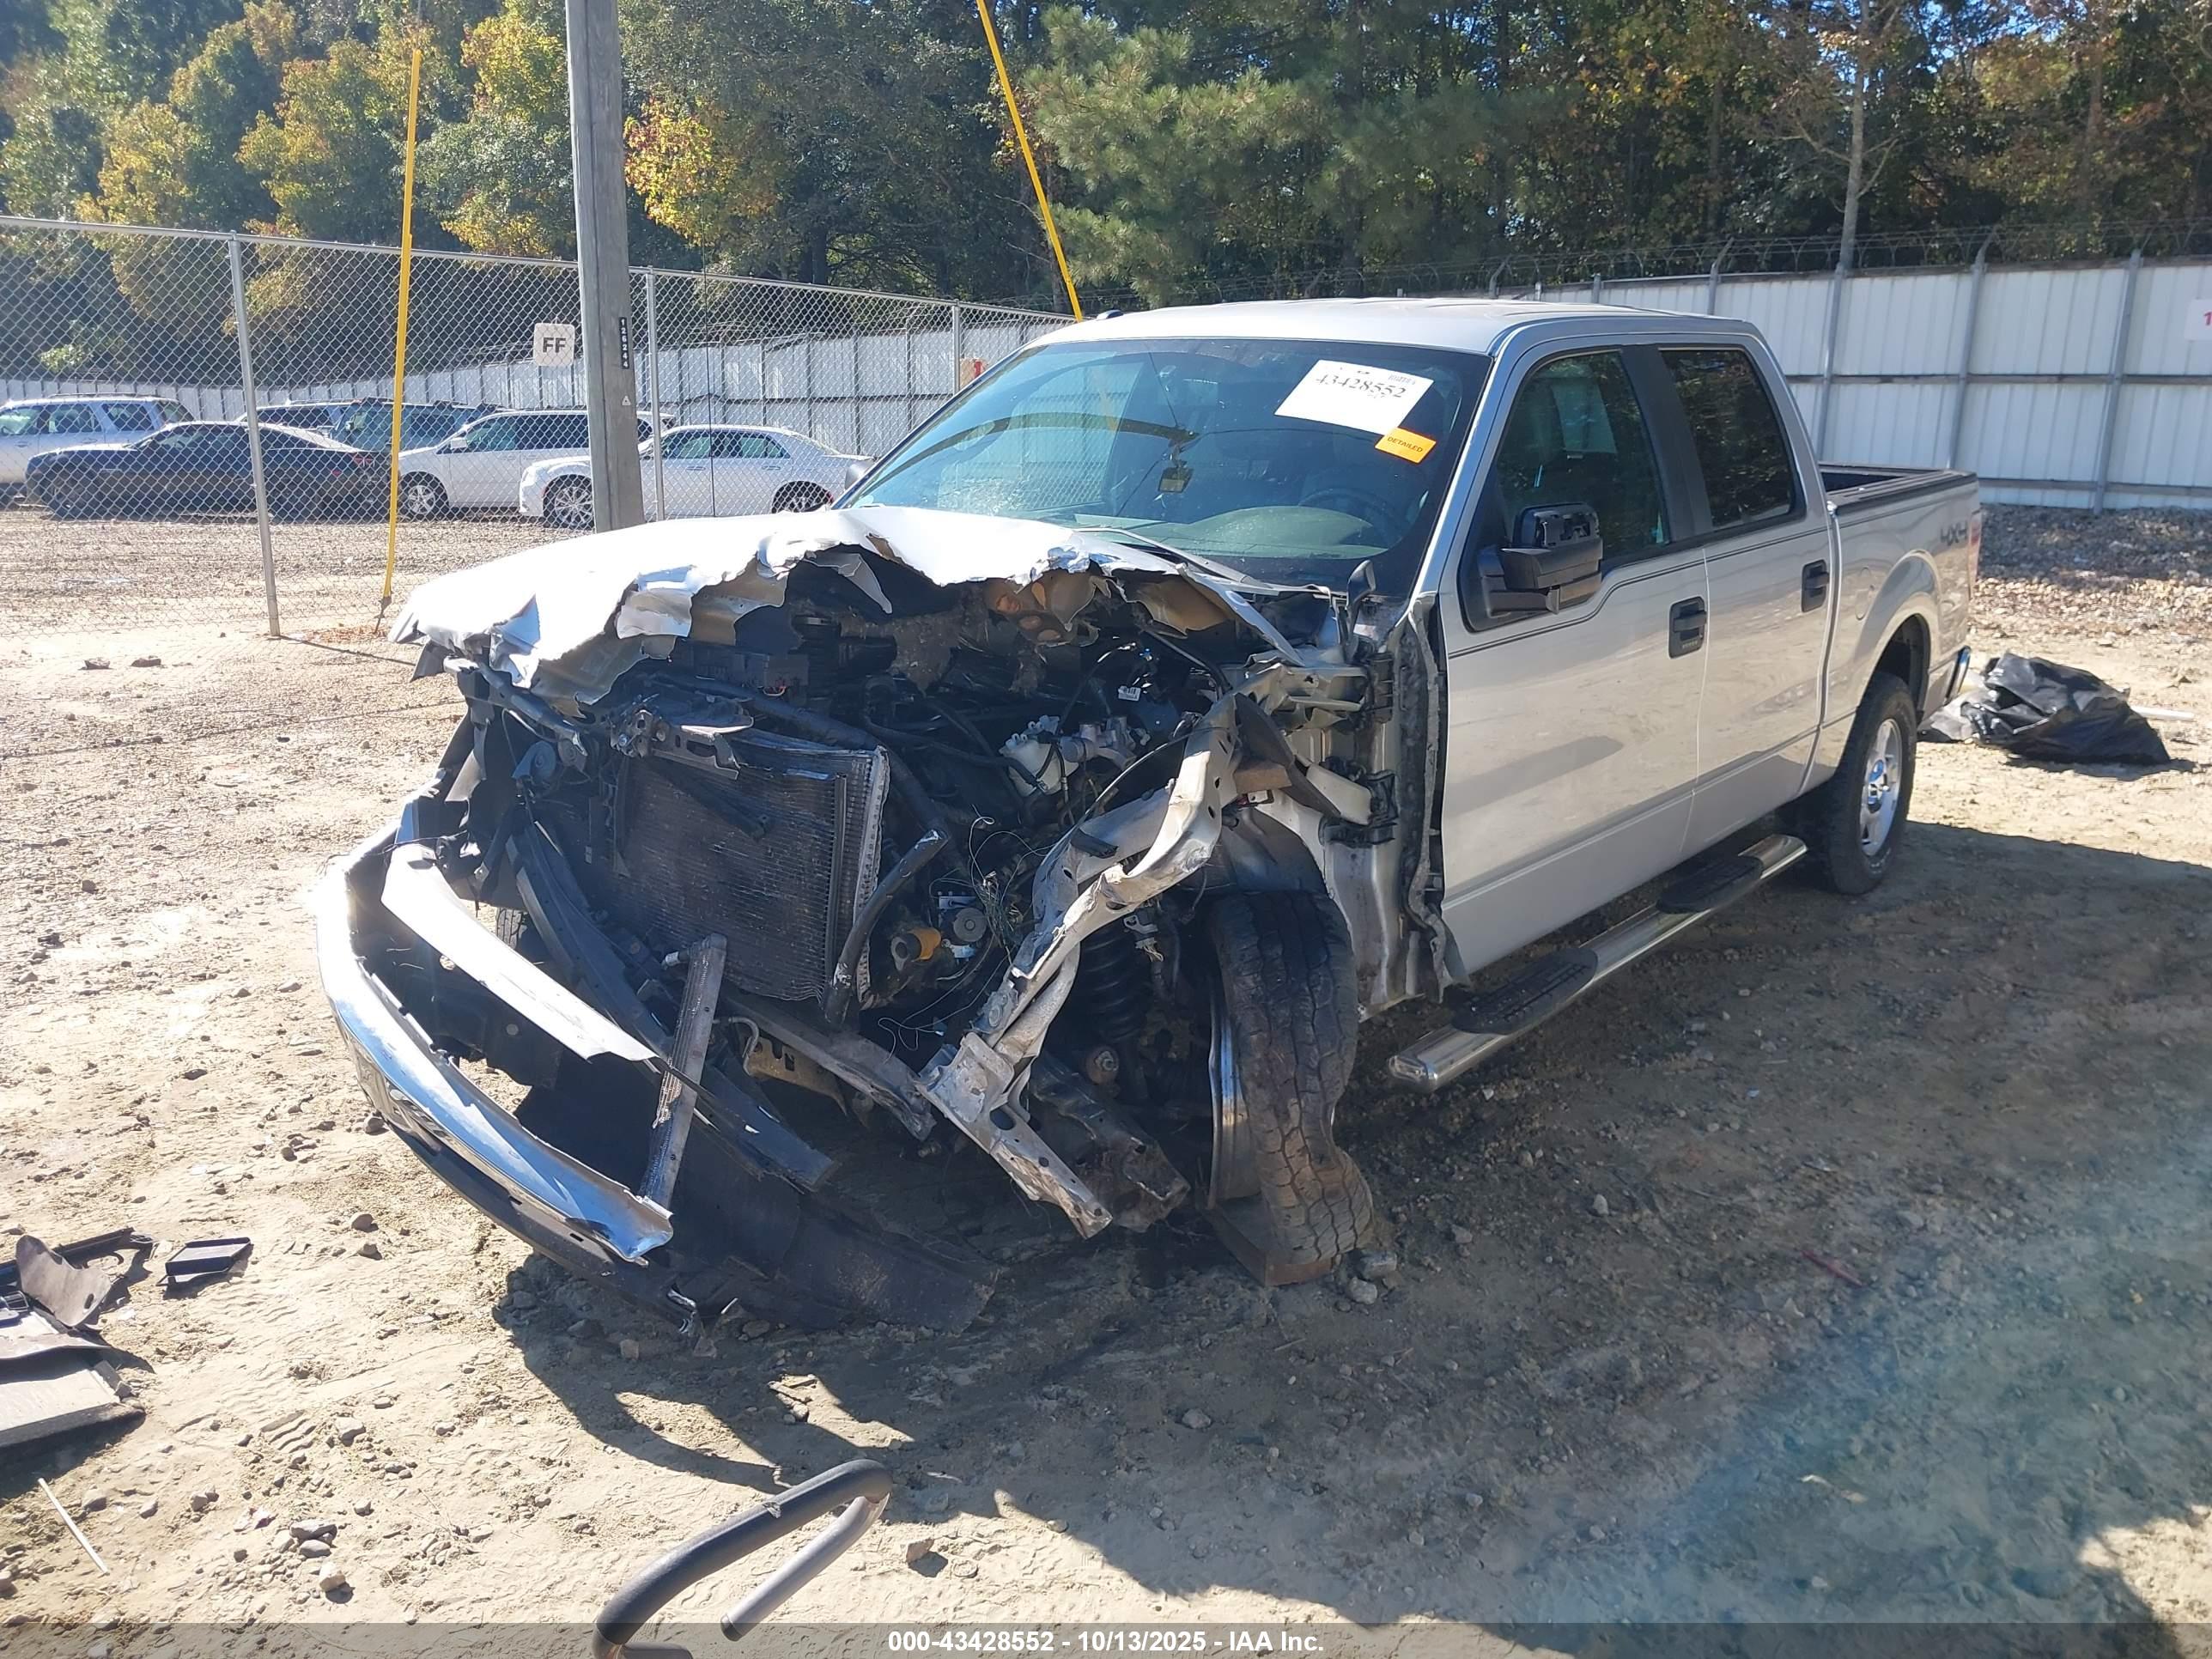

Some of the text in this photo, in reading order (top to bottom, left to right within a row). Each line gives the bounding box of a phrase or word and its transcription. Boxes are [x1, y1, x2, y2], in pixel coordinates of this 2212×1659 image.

[543, 337, 566, 353] FF
[1316, 374, 1407, 398] 43428552
[1387, 436, 1424, 453] DETAILED
